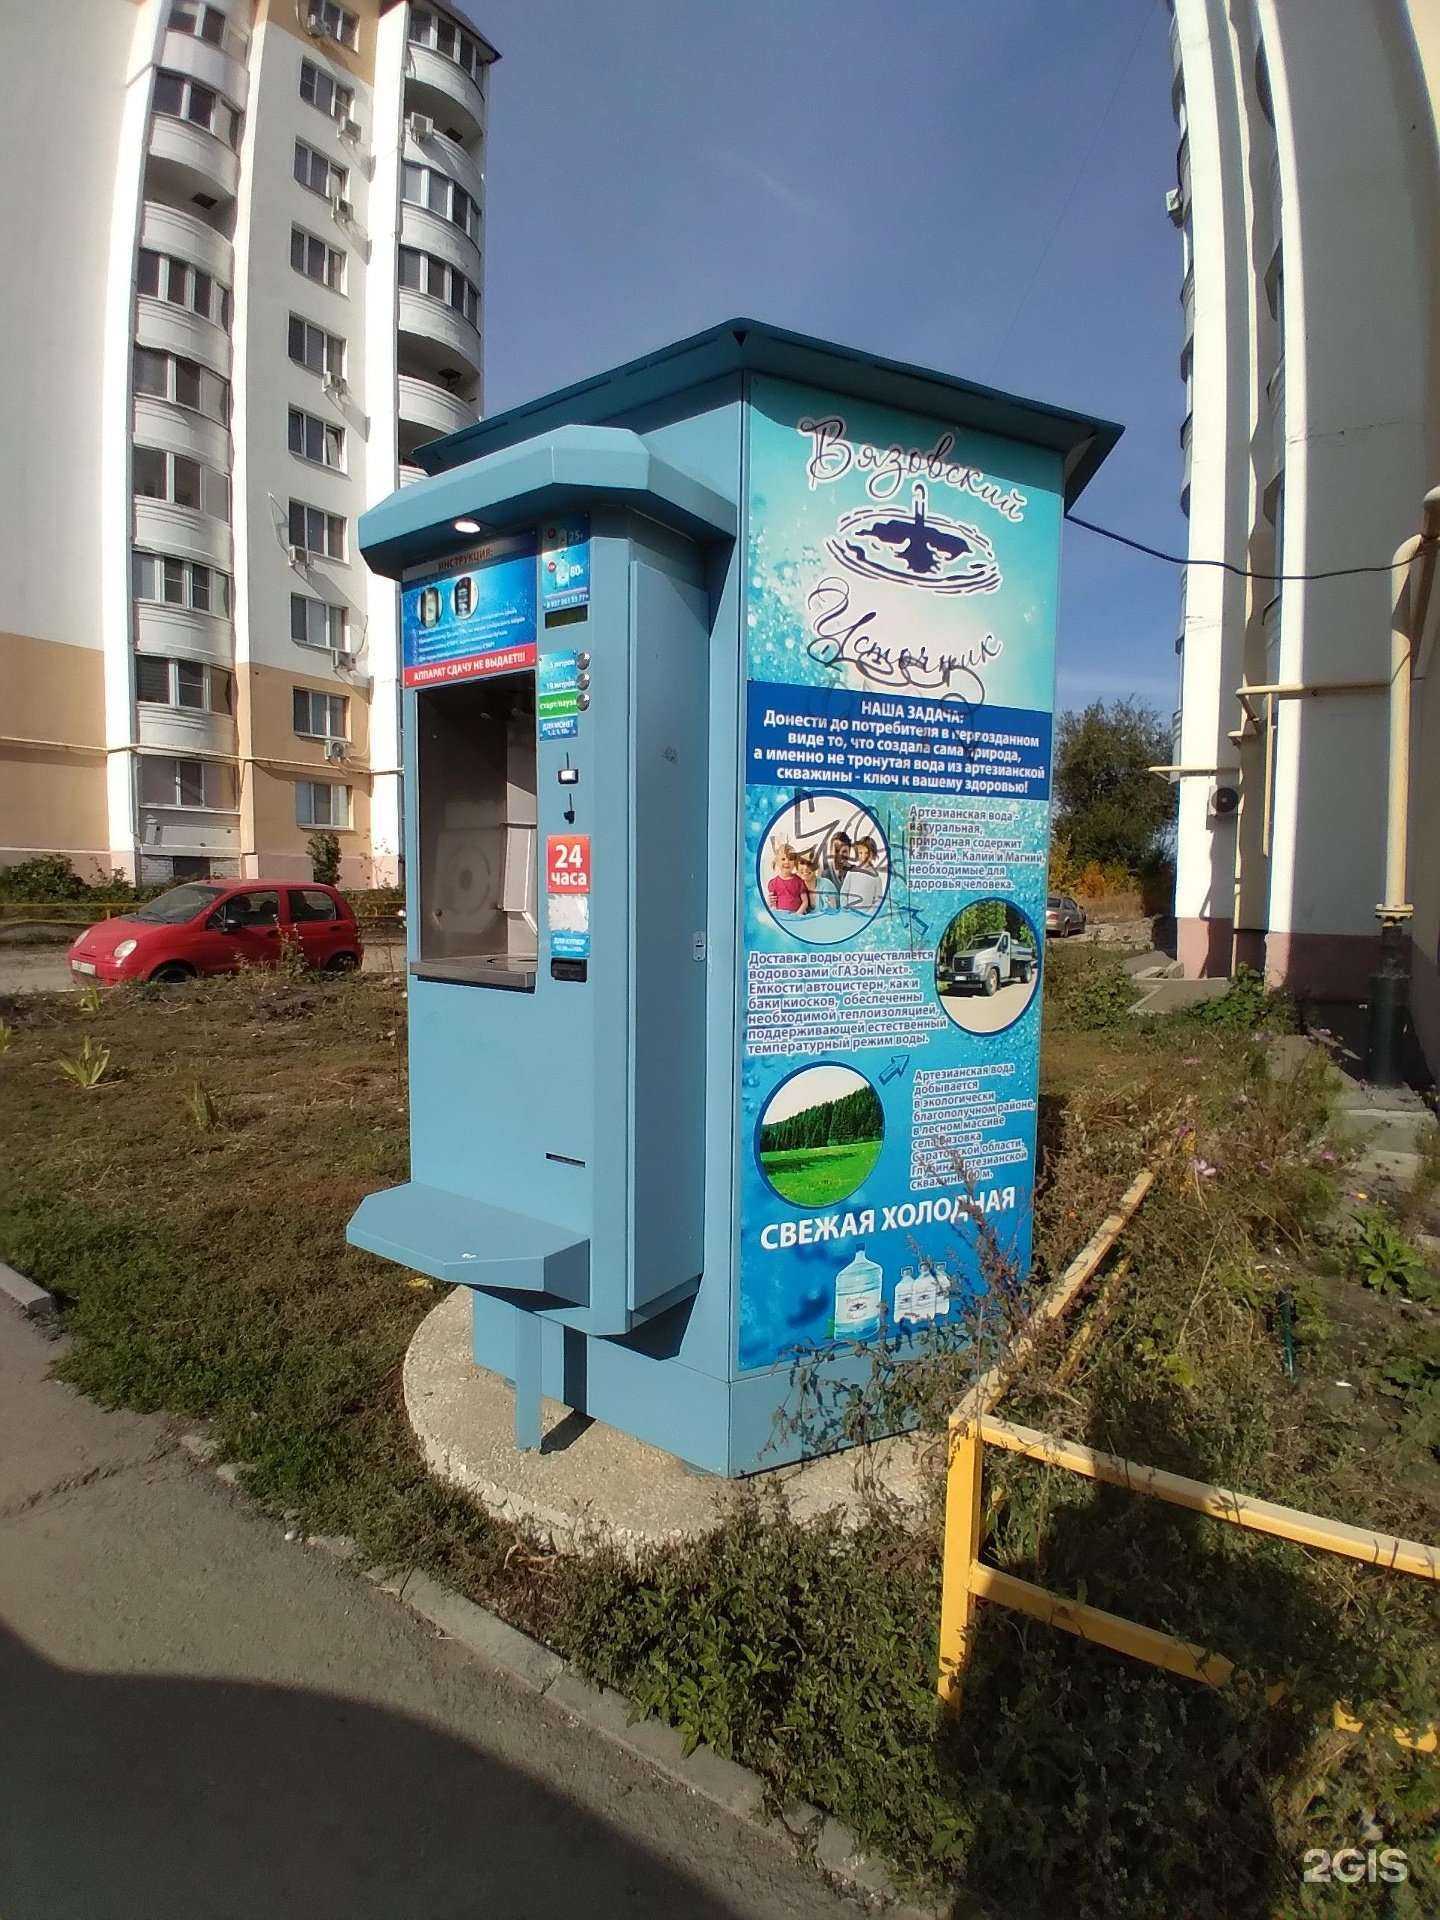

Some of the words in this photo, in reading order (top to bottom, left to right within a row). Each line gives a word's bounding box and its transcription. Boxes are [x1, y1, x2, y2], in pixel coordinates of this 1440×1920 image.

[801, 418, 1026, 520] Вязовский
[808, 576, 1003, 673] Источник
[414, 666, 445, 681] АППАРАТ
[447, 662, 472, 677] СДАЧУ
[474, 660, 484, 671] НЕ
[861, 700, 904, 718] НАША
[907, 705, 965, 724] ЗАДАЧА:
[763, 709, 827, 729] Донести
[830, 719, 848, 732] до
[852, 720, 939, 738] потребителя
[942, 728, 949, 739] в
[788, 733, 824, 748] виде
[827, 738, 847, 749] то,
[851, 738, 874, 750] что
[877, 741, 931, 755] создала
[933, 744, 964, 757] сама
[753, 748, 762, 760] а
[766, 749, 824, 764] именно
[827, 753, 844, 764] не
[848, 754, 910, 771] тронутая
[914, 759, 945, 773] вода
[947, 762, 963, 771] из
[965, 763, 1045, 779] артезианской
[777, 767, 852, 782] скважины
[863, 773, 899, 785] ключ
[902, 775, 909, 786] к
[912, 775, 963, 791] вашему
[965, 781, 1028, 794] здоровью!
[910, 806, 986, 820] Артезианская
[988, 811, 1013, 822] вода
[909, 822, 984, 836] натуральная,
[909, 837, 970, 850] природная
[973, 839, 1022, 850] содержит
[554, 844, 583, 869] 24
[909, 848, 960, 861] Кальций,
[962, 850, 995, 862] Калий
[996, 852, 1003, 862] и
[551, 871, 588, 886] часа
[909, 864, 985, 877] необходимые
[987, 867, 1006, 876] для
[908, 880, 962, 891] здоровья
[963, 880, 1014, 889] человека.
[749, 953, 808, 966] Доставка
[810, 954, 841, 964] воды
[844, 951, 934, 965] осуществляется
[749, 968, 829, 980] водовозами
[831, 965, 874, 977] «ГАЗон
[876, 964, 912, 976] Next».
[749, 983, 803, 994] Емкости
[806, 981, 887, 993] автоцистерн,
[889, 979, 910, 989] как
[912, 979, 919, 988] и
[748, 997, 780, 1009] баки
[783, 997, 838, 1008] киосков,
[844, 994, 923, 1005] обеспеченны
[748, 1009, 836, 1024] необходимой
[840, 1004, 939, 1019] теплоизоляцией,
[748, 1022, 865, 1040] поддерживающей
[868, 1018, 947, 1032] естественный
[748, 1037, 850, 1053] температурный
[853, 1036, 893, 1050] режим
[896, 1033, 929, 1046] воды.
[915, 1067, 988, 1083] Артезианская
[991, 1063, 1014, 1075] вода
[914, 1080, 978, 1096] добывается
[914, 1101, 920, 1109] в
[923, 1092, 995, 1108] экологически
[913, 1104, 996, 1122] благополучном
[913, 1127, 919, 1135] в
[922, 1122, 961, 1135] лесном
[963, 1117, 1005, 1130] массиве
[912, 1143, 979, 1162] Саратовкой
[982, 1140, 1025, 1153] области.
[958, 1150, 1027, 1168] ртезианской
[760, 1209, 875, 1250] СВЕЖАЯ
[881, 1186, 1015, 1231] ХОЛОДНАЯ
